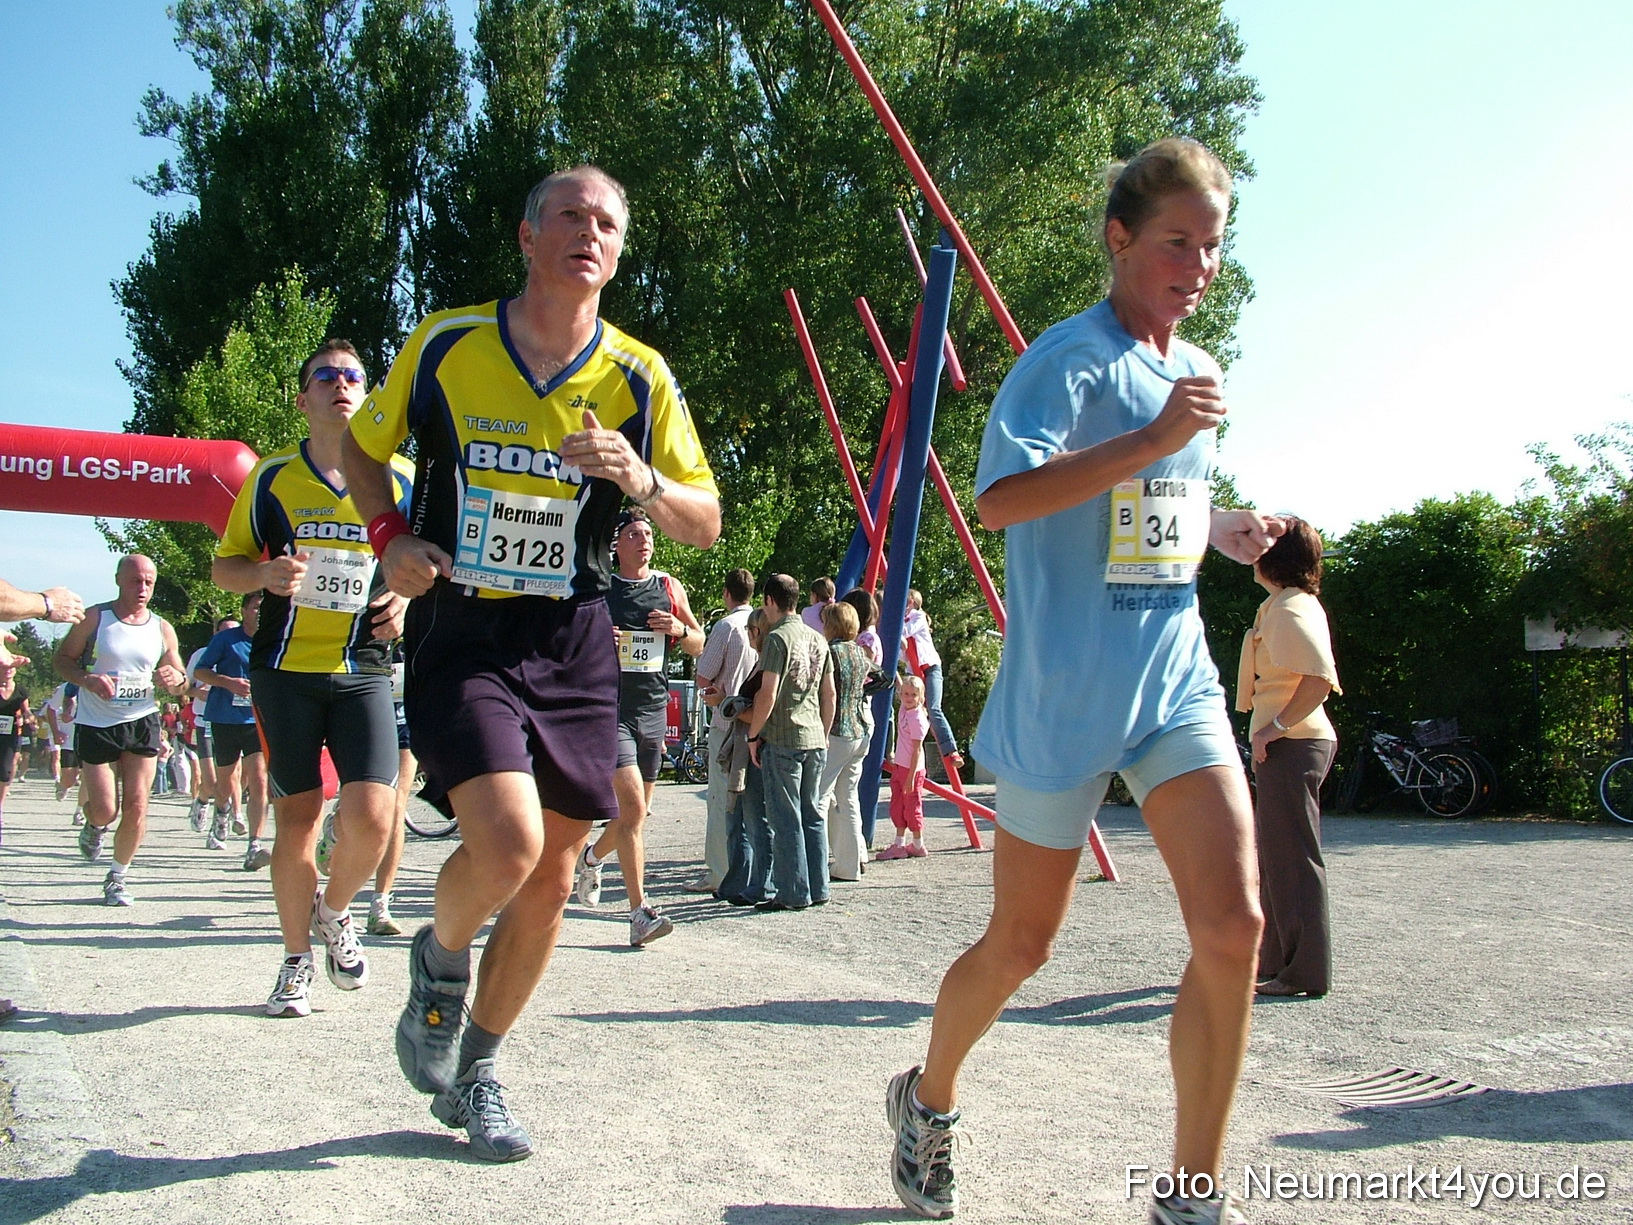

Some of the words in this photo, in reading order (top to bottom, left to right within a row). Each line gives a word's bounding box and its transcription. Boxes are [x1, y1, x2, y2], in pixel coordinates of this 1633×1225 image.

[464, 416, 528, 435] TEAM
[63, 455, 192, 485] LGS-Park
[293, 508, 336, 518] TEAM
[492, 502, 564, 527] Hermann
[1119, 508, 1132, 525] B
[466, 523, 479, 539] B
[1146, 515, 1179, 548] 34
[488, 534, 565, 570] 3128
[321, 555, 365, 567] Johannes
[315, 575, 363, 596] 3519
[526, 579, 566, 590] PFLEIDERER
[632, 635, 655, 645] Jürgen
[622, 645, 628, 653] B
[632, 648, 649, 661] 48
[119, 687, 147, 698] 2081
